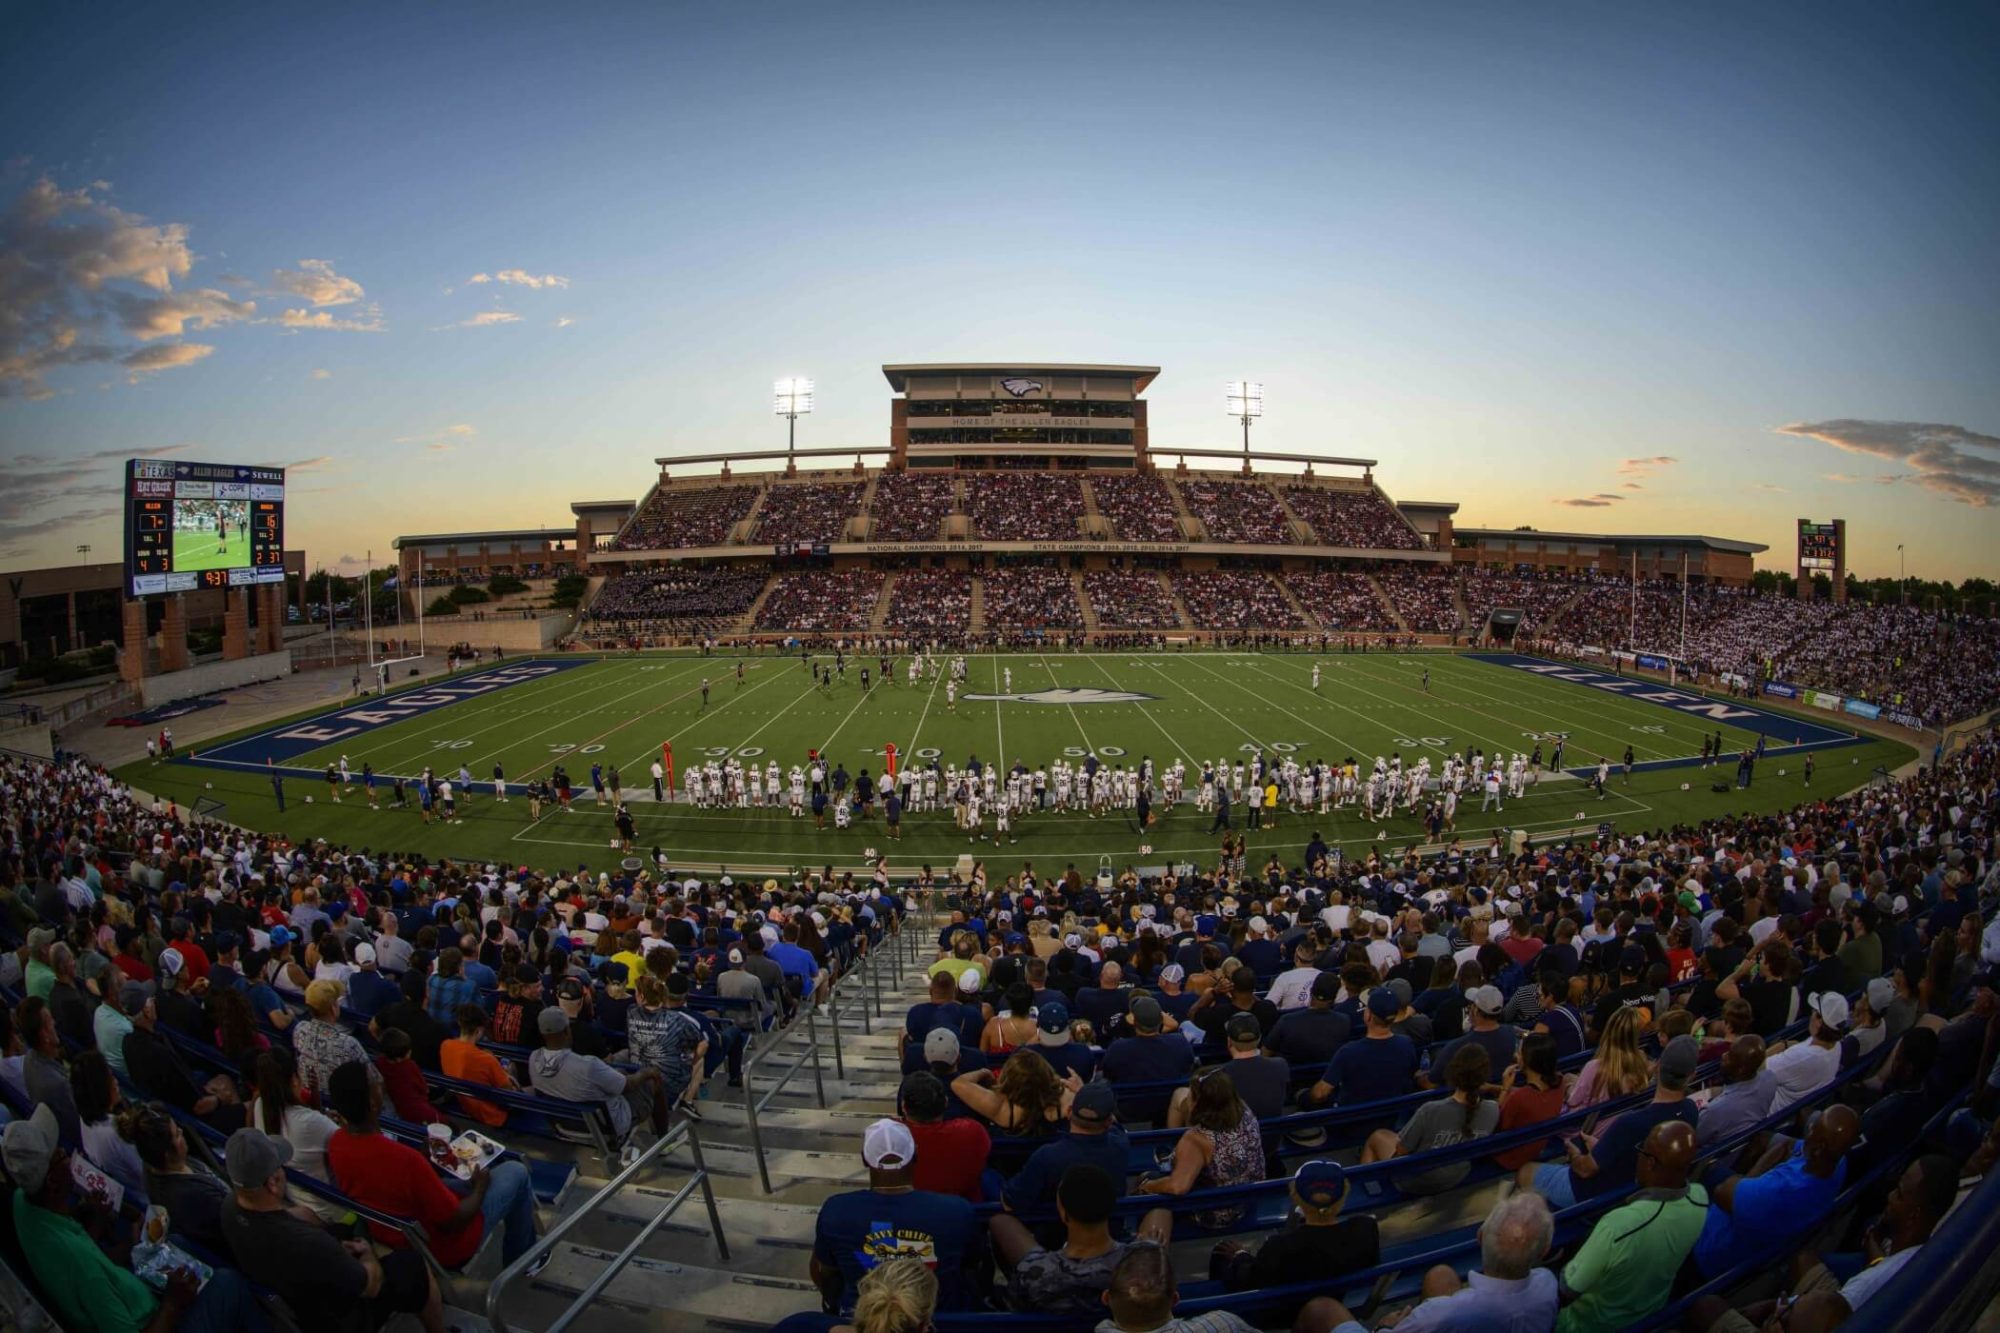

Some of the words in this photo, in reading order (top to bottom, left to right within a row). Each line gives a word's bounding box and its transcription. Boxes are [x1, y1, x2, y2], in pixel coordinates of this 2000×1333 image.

[1021, 418, 1051, 426] ALLEN
[1055, 418, 1090, 426] EAGLES
[147, 466, 175, 478] TEXAS
[252, 471, 282, 480] SEWELL
[150, 515, 156, 528] 7
[256, 552, 262, 564] 2
[270, 551, 280, 563] 37
[140, 560, 147, 571] 4
[162, 558, 168, 571] 3
[206, 571, 227, 585] 9:37
[1511, 664, 1761, 719] ALLEN
[1767, 683, 1793, 694] Academy
[273, 667, 558, 740] EAGLES
[1238, 742, 1298, 752] 40
[1392, 736, 1448, 747] 30
[547, 743, 606, 754] 20
[703, 746, 765, 757] 30
[1063, 746, 1125, 756] 50
[610, 839, 619, 848] 30
[864, 848, 875, 857] 40
[1141, 845, 1152, 854] 50
[864, 1229, 893, 1242] NAVY
[897, 1229, 933, 1243] CHIEF
